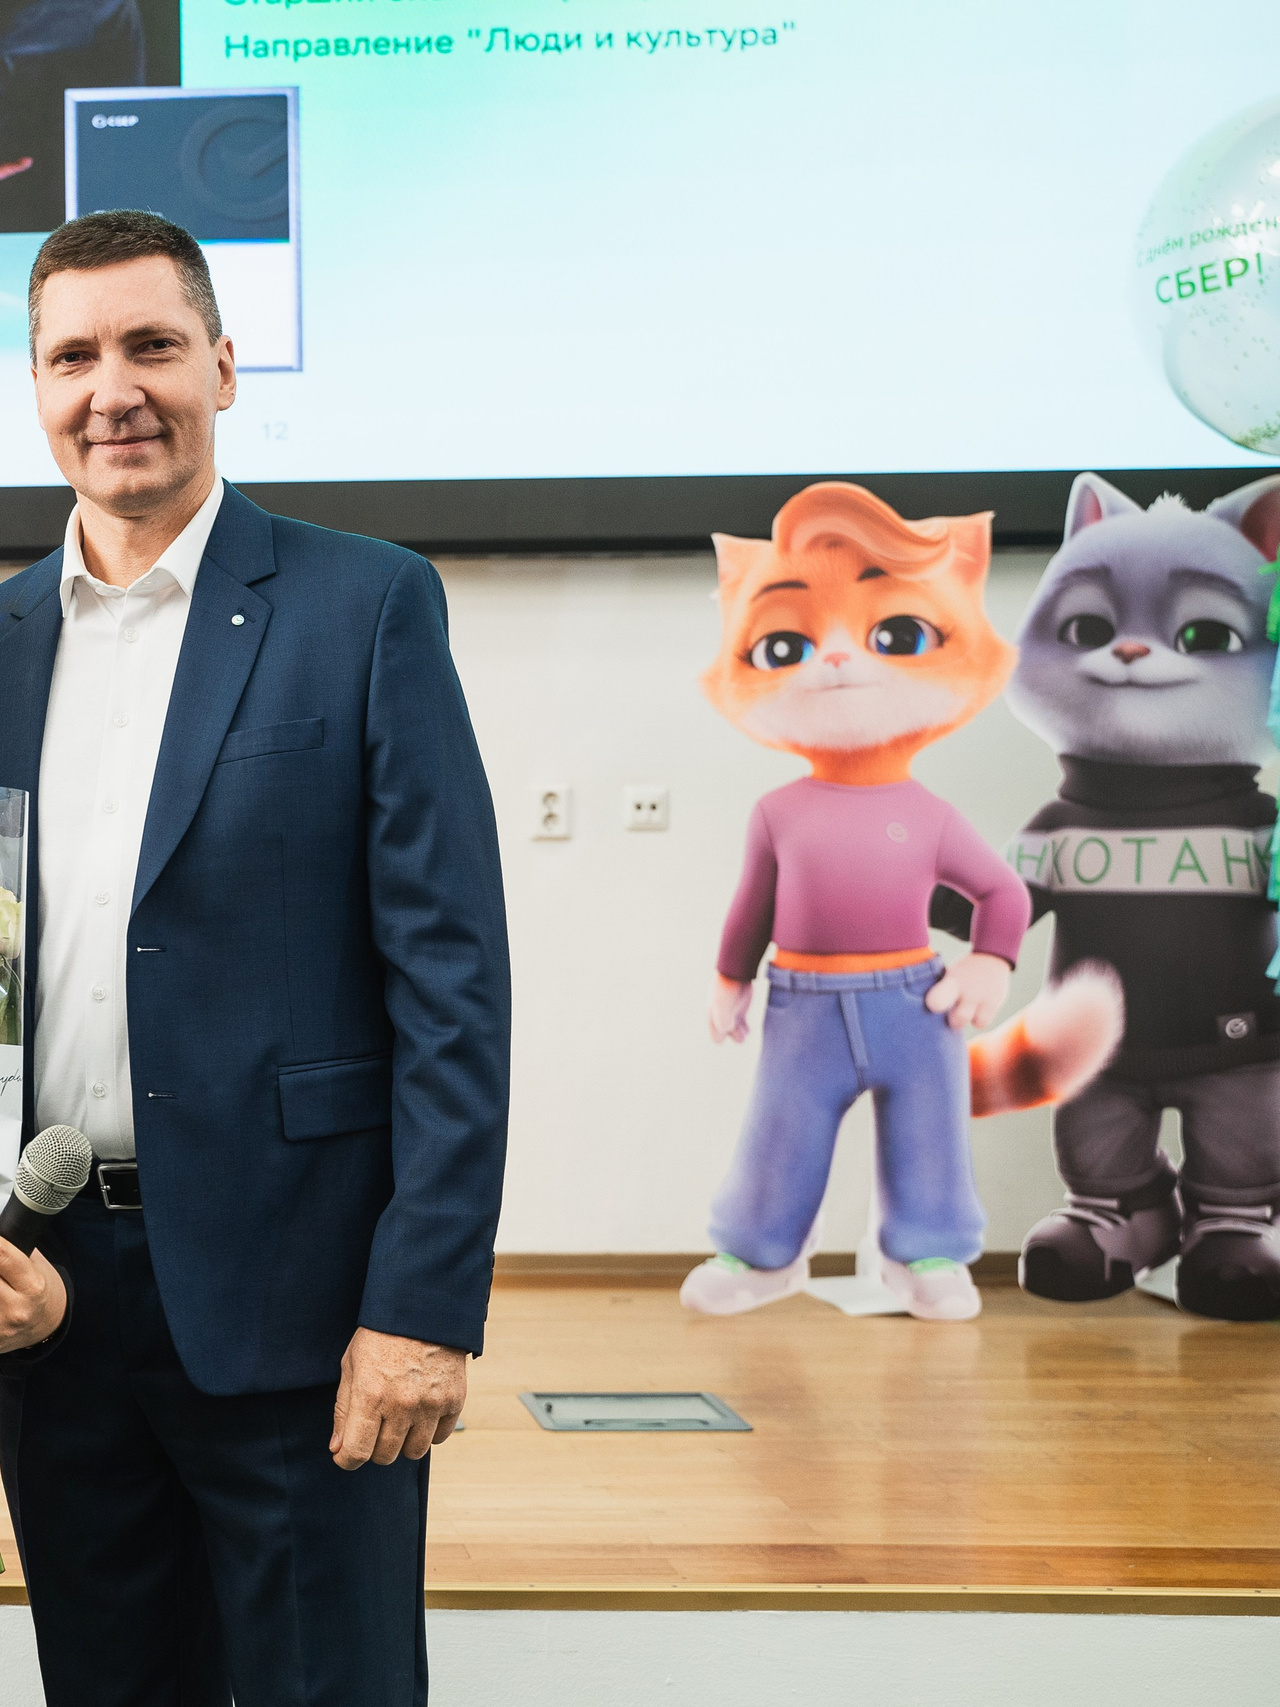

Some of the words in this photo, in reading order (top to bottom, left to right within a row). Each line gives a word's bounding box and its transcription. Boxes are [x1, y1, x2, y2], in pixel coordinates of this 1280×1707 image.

[225, 34, 455, 63] Направление
[467, 27, 582, 54] "Люди
[595, 32, 614, 49] и
[626, 20, 796, 54] культура"
[1155, 252, 1265, 304] СБЕР!
